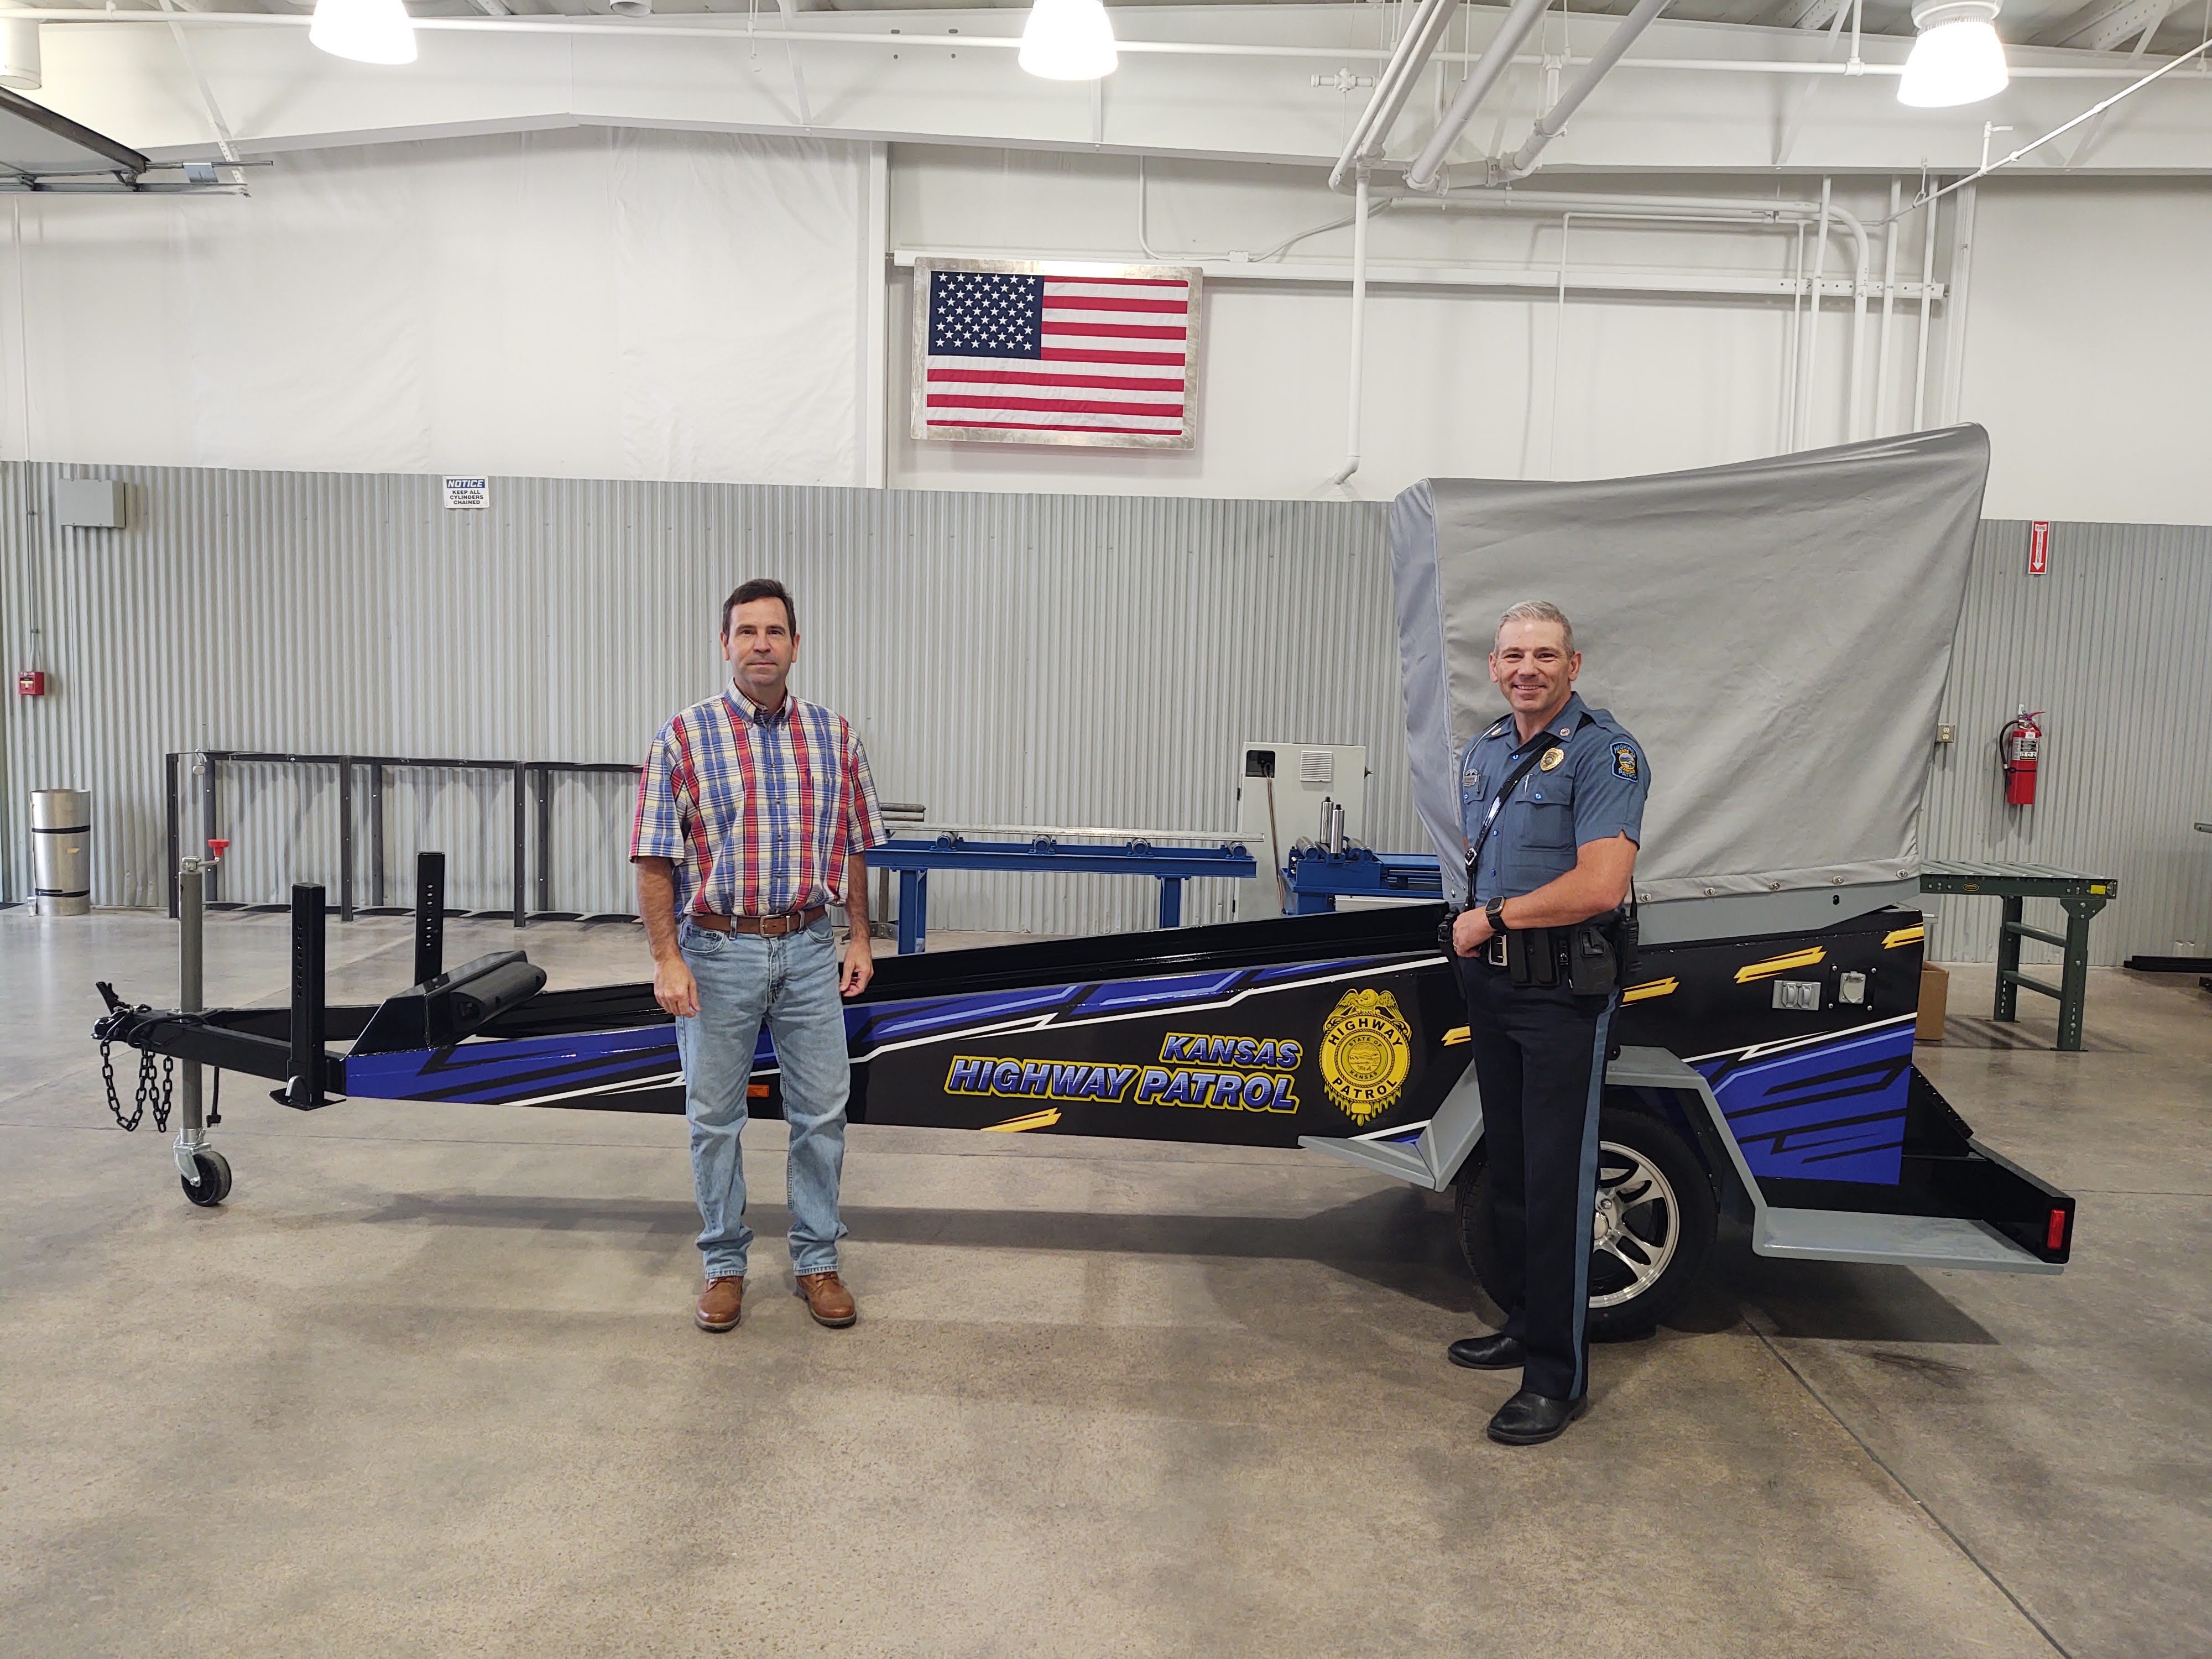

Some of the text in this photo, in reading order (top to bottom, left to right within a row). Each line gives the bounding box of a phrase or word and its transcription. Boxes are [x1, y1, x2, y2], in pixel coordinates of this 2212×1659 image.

[447, 479, 484, 488] NOTICE
[1328, 1018, 1403, 1046] HIGHWAY
[1349, 1037, 1371, 1047] STATE
[1161, 1034, 1301, 1069] KANSAS
[946, 1057, 1298, 1112] HIGHWAY PATROL
[1349, 1070, 1378, 1079] KANSAS
[1332, 1077, 1397, 1099] PATROL
